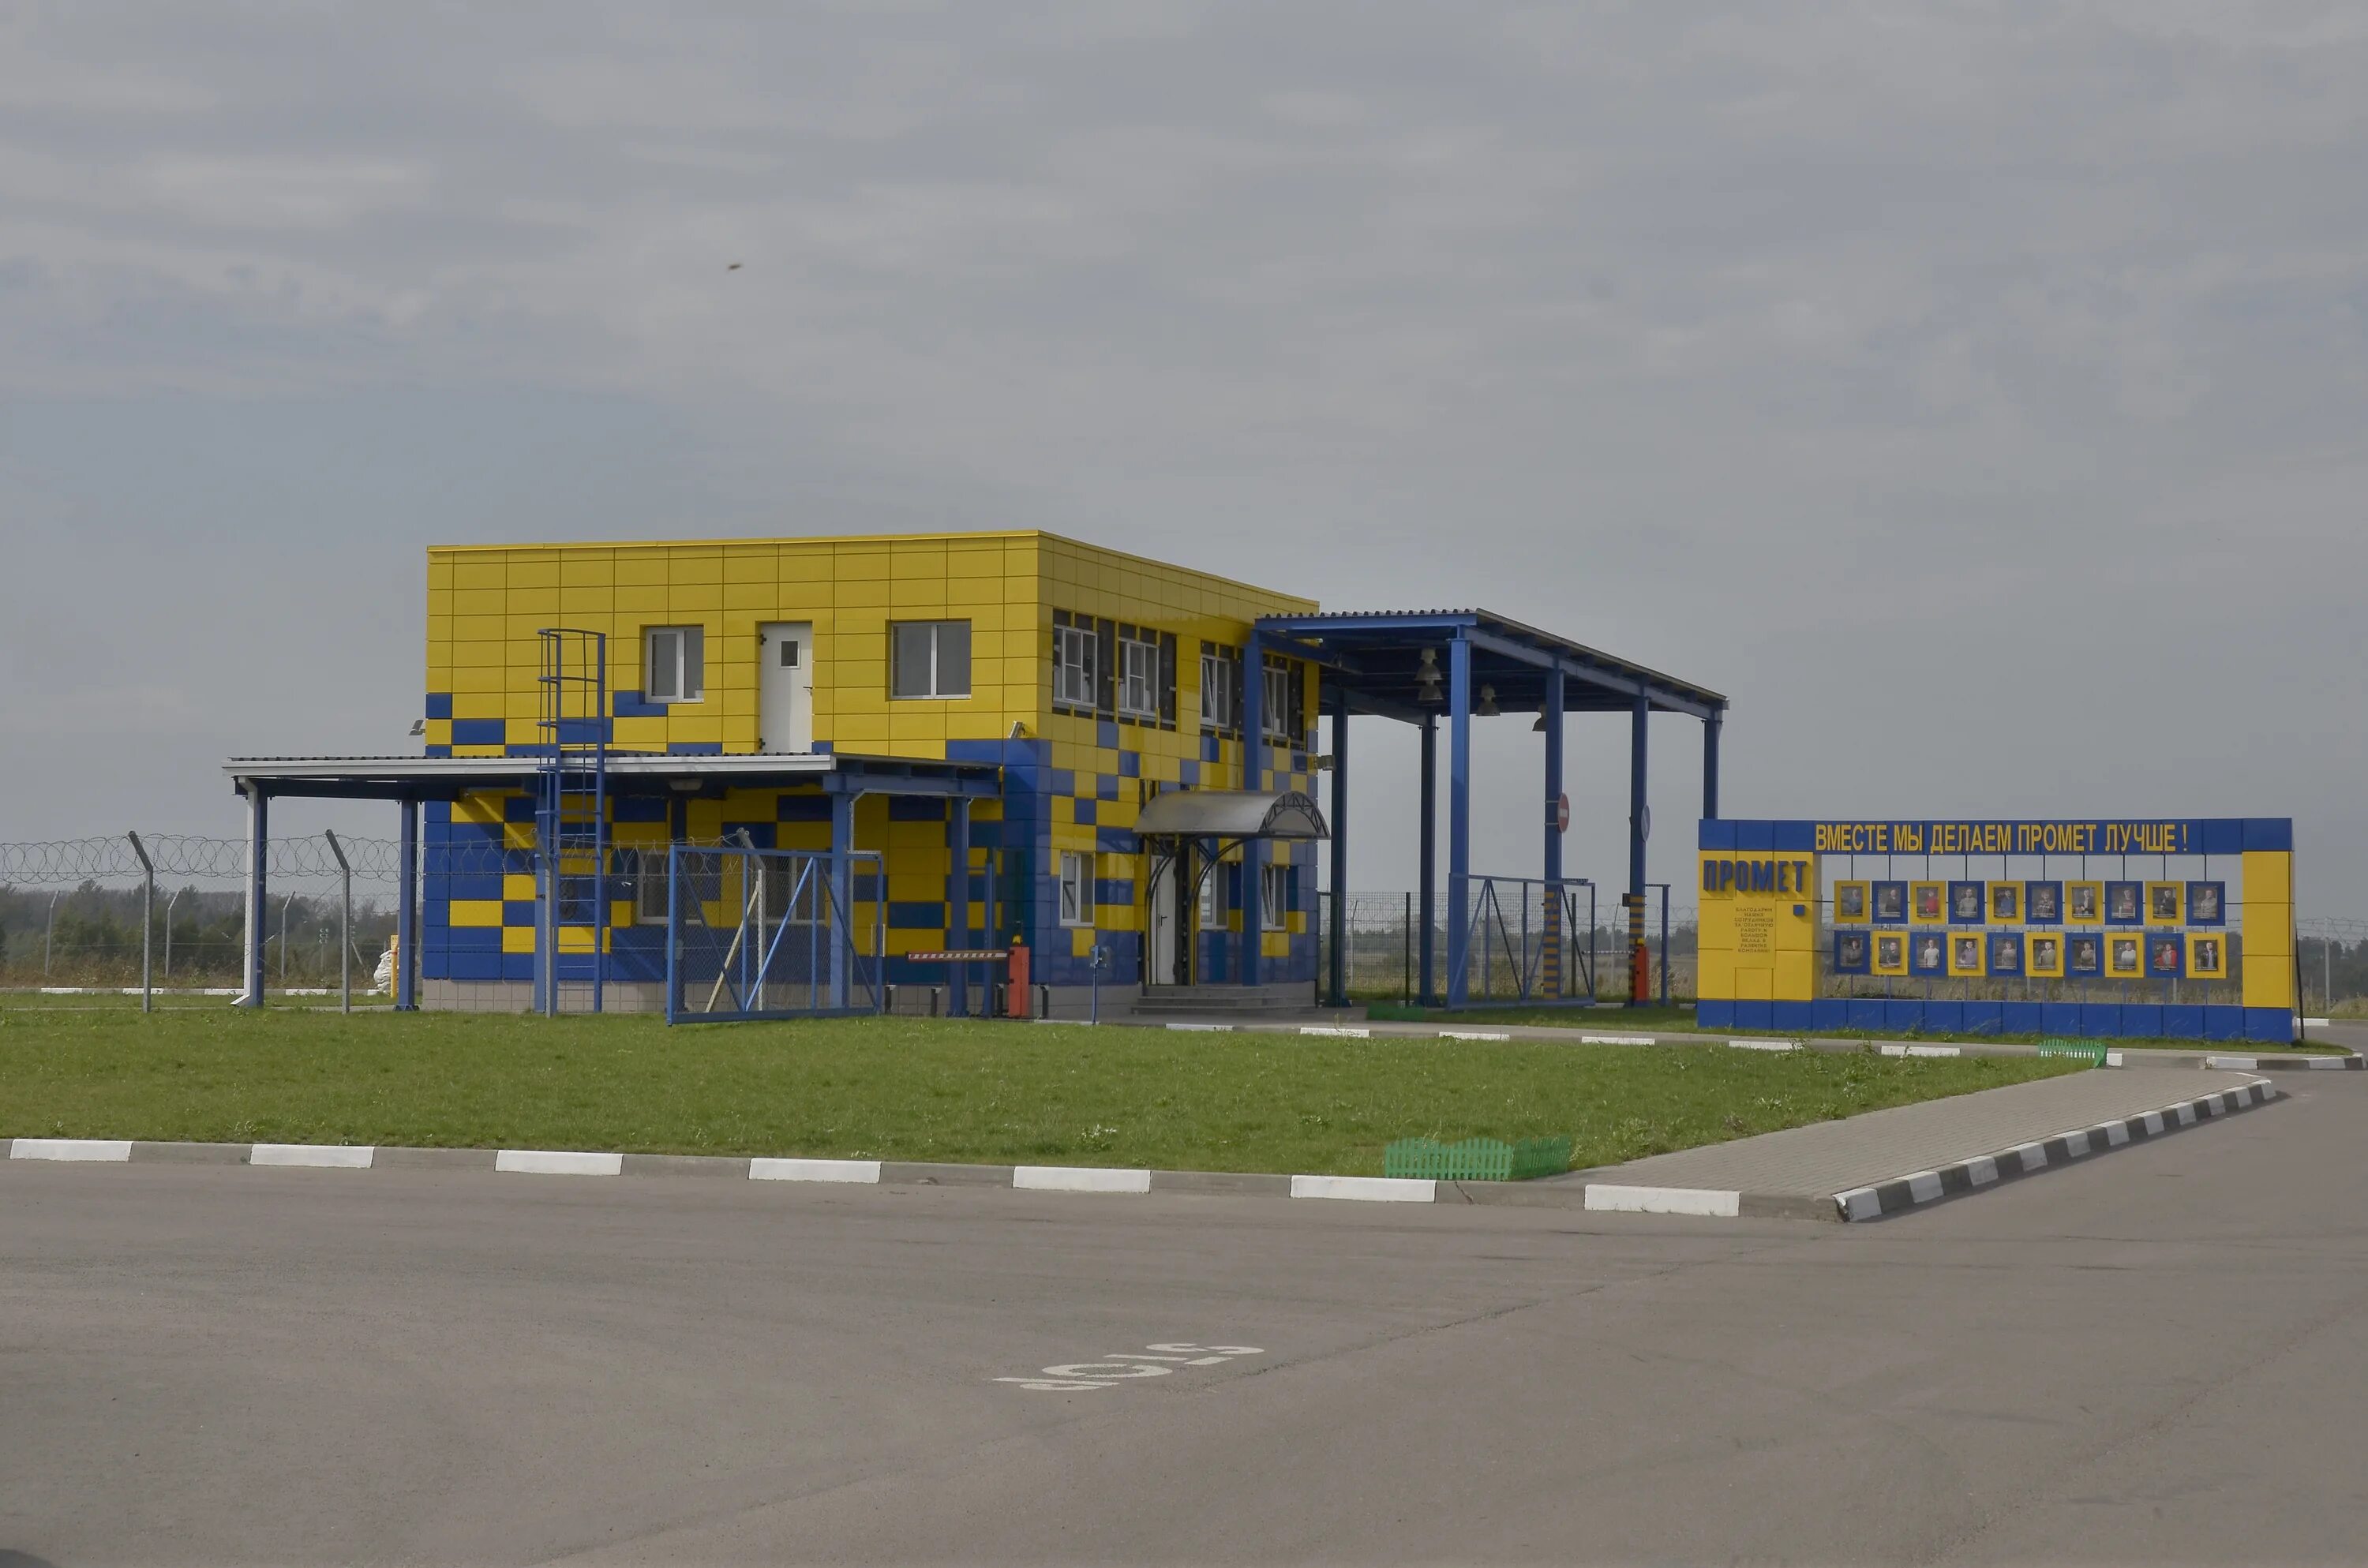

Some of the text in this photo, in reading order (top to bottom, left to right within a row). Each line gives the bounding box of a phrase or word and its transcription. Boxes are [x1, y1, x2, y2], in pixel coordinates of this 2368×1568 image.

[1815, 825, 1888, 853] ВМЕСТЕ
[1894, 825, 1924, 852] МЫ
[1931, 825, 2012, 855] ДЕЛАЕМ
[2018, 825, 2097, 852] ПРОМЕТ
[2105, 824, 2177, 852] ЛУЧШЕ
[1703, 859, 1807, 892] ПРОМЕТ
